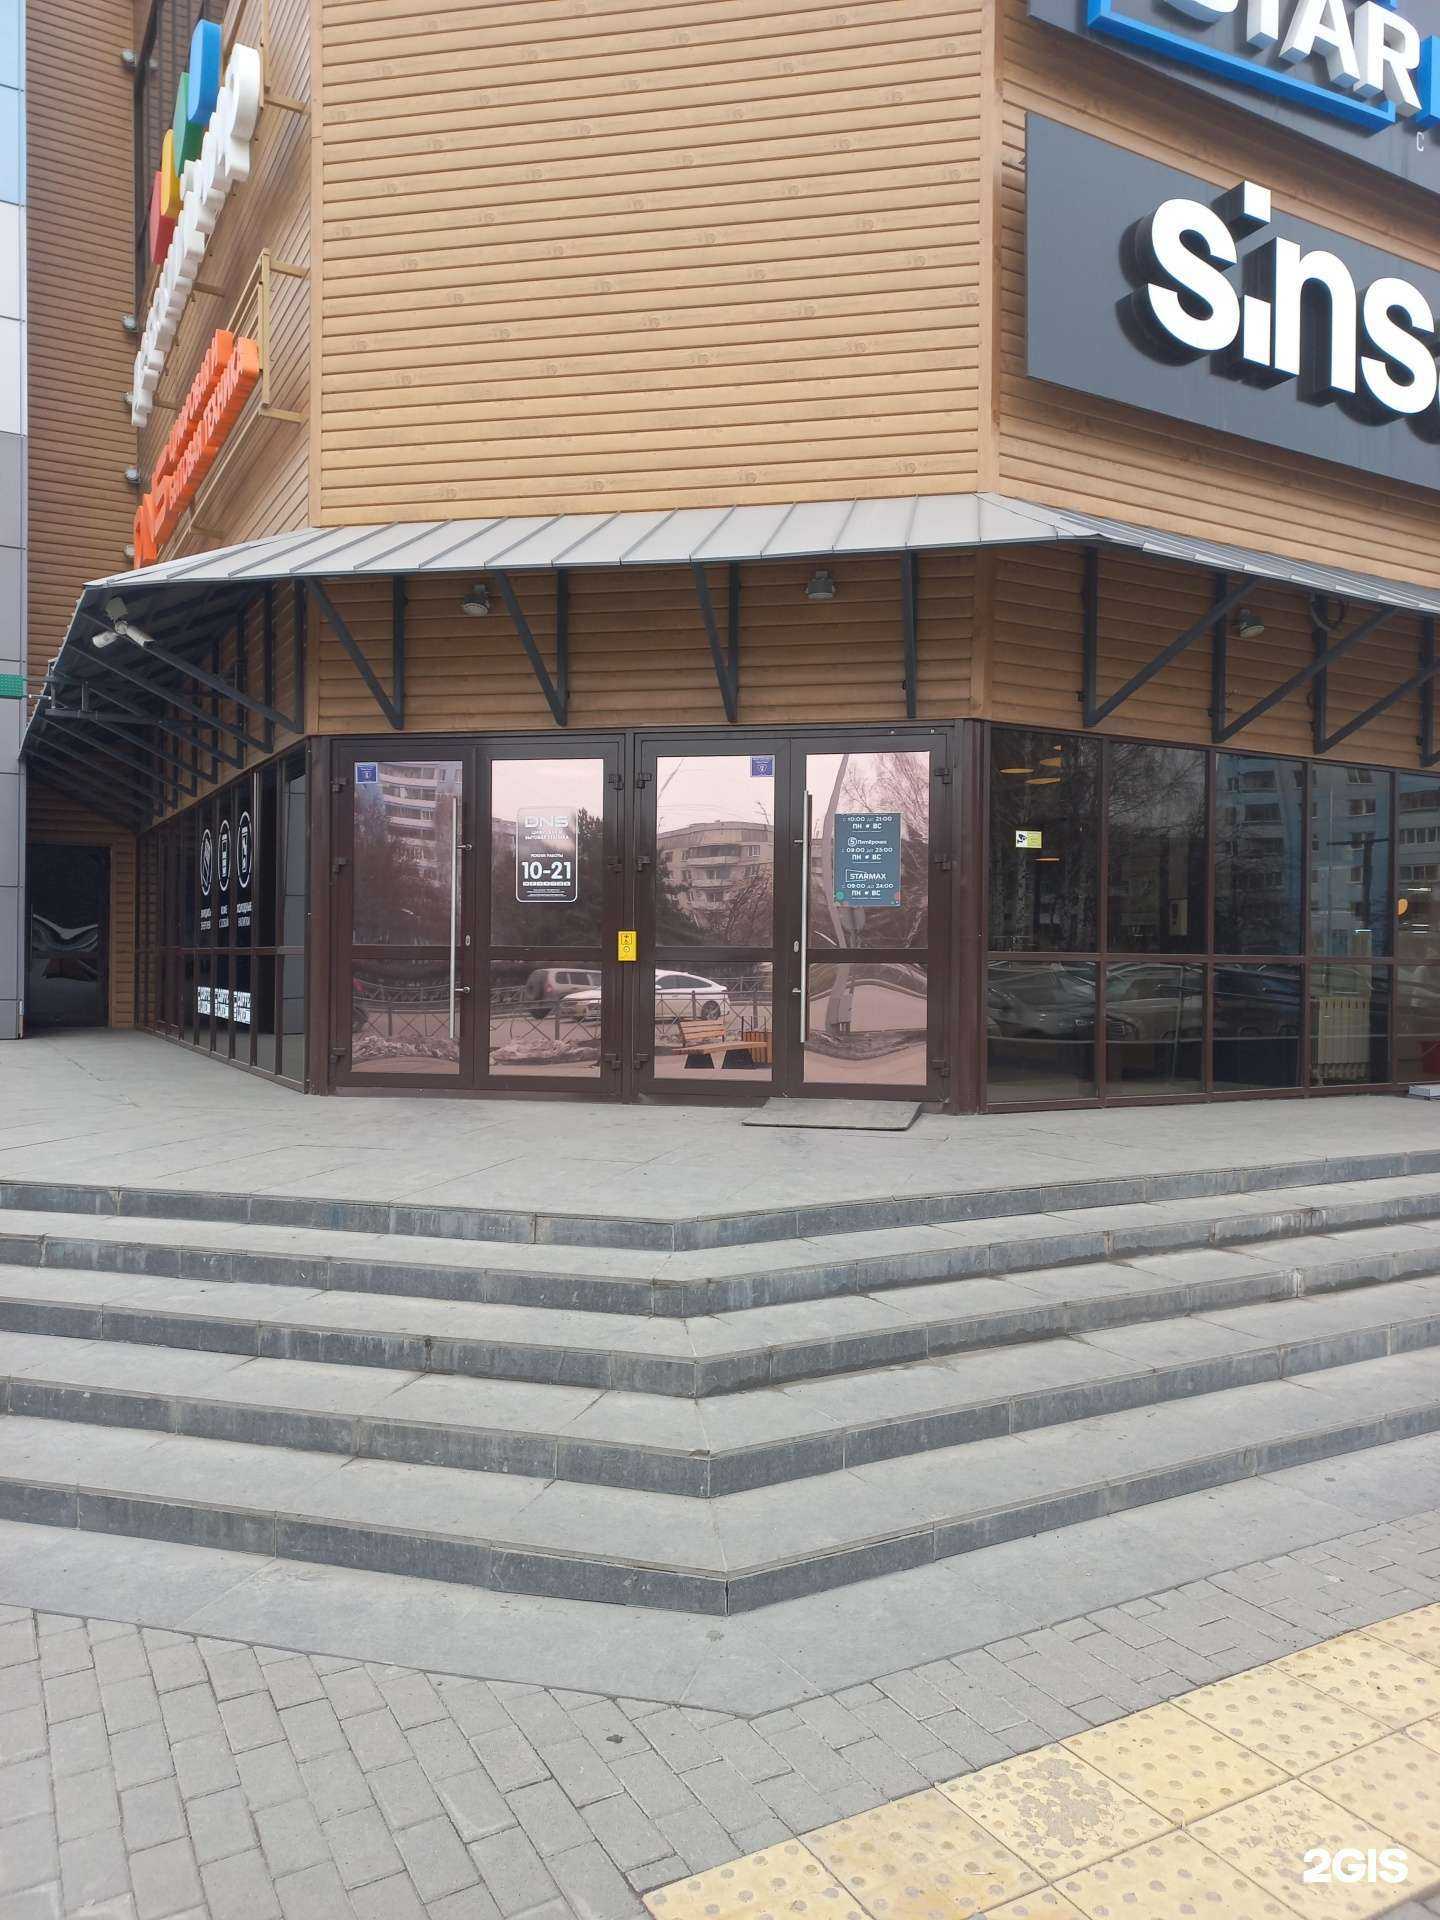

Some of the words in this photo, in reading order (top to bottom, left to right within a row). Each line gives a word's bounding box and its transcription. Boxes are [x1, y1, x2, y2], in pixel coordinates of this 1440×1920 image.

[1147, 180, 1440, 414] Sins
[525, 816, 568, 828] DNS
[521, 861, 571, 880] 10-21
[849, 872, 887, 880] STARMAX
